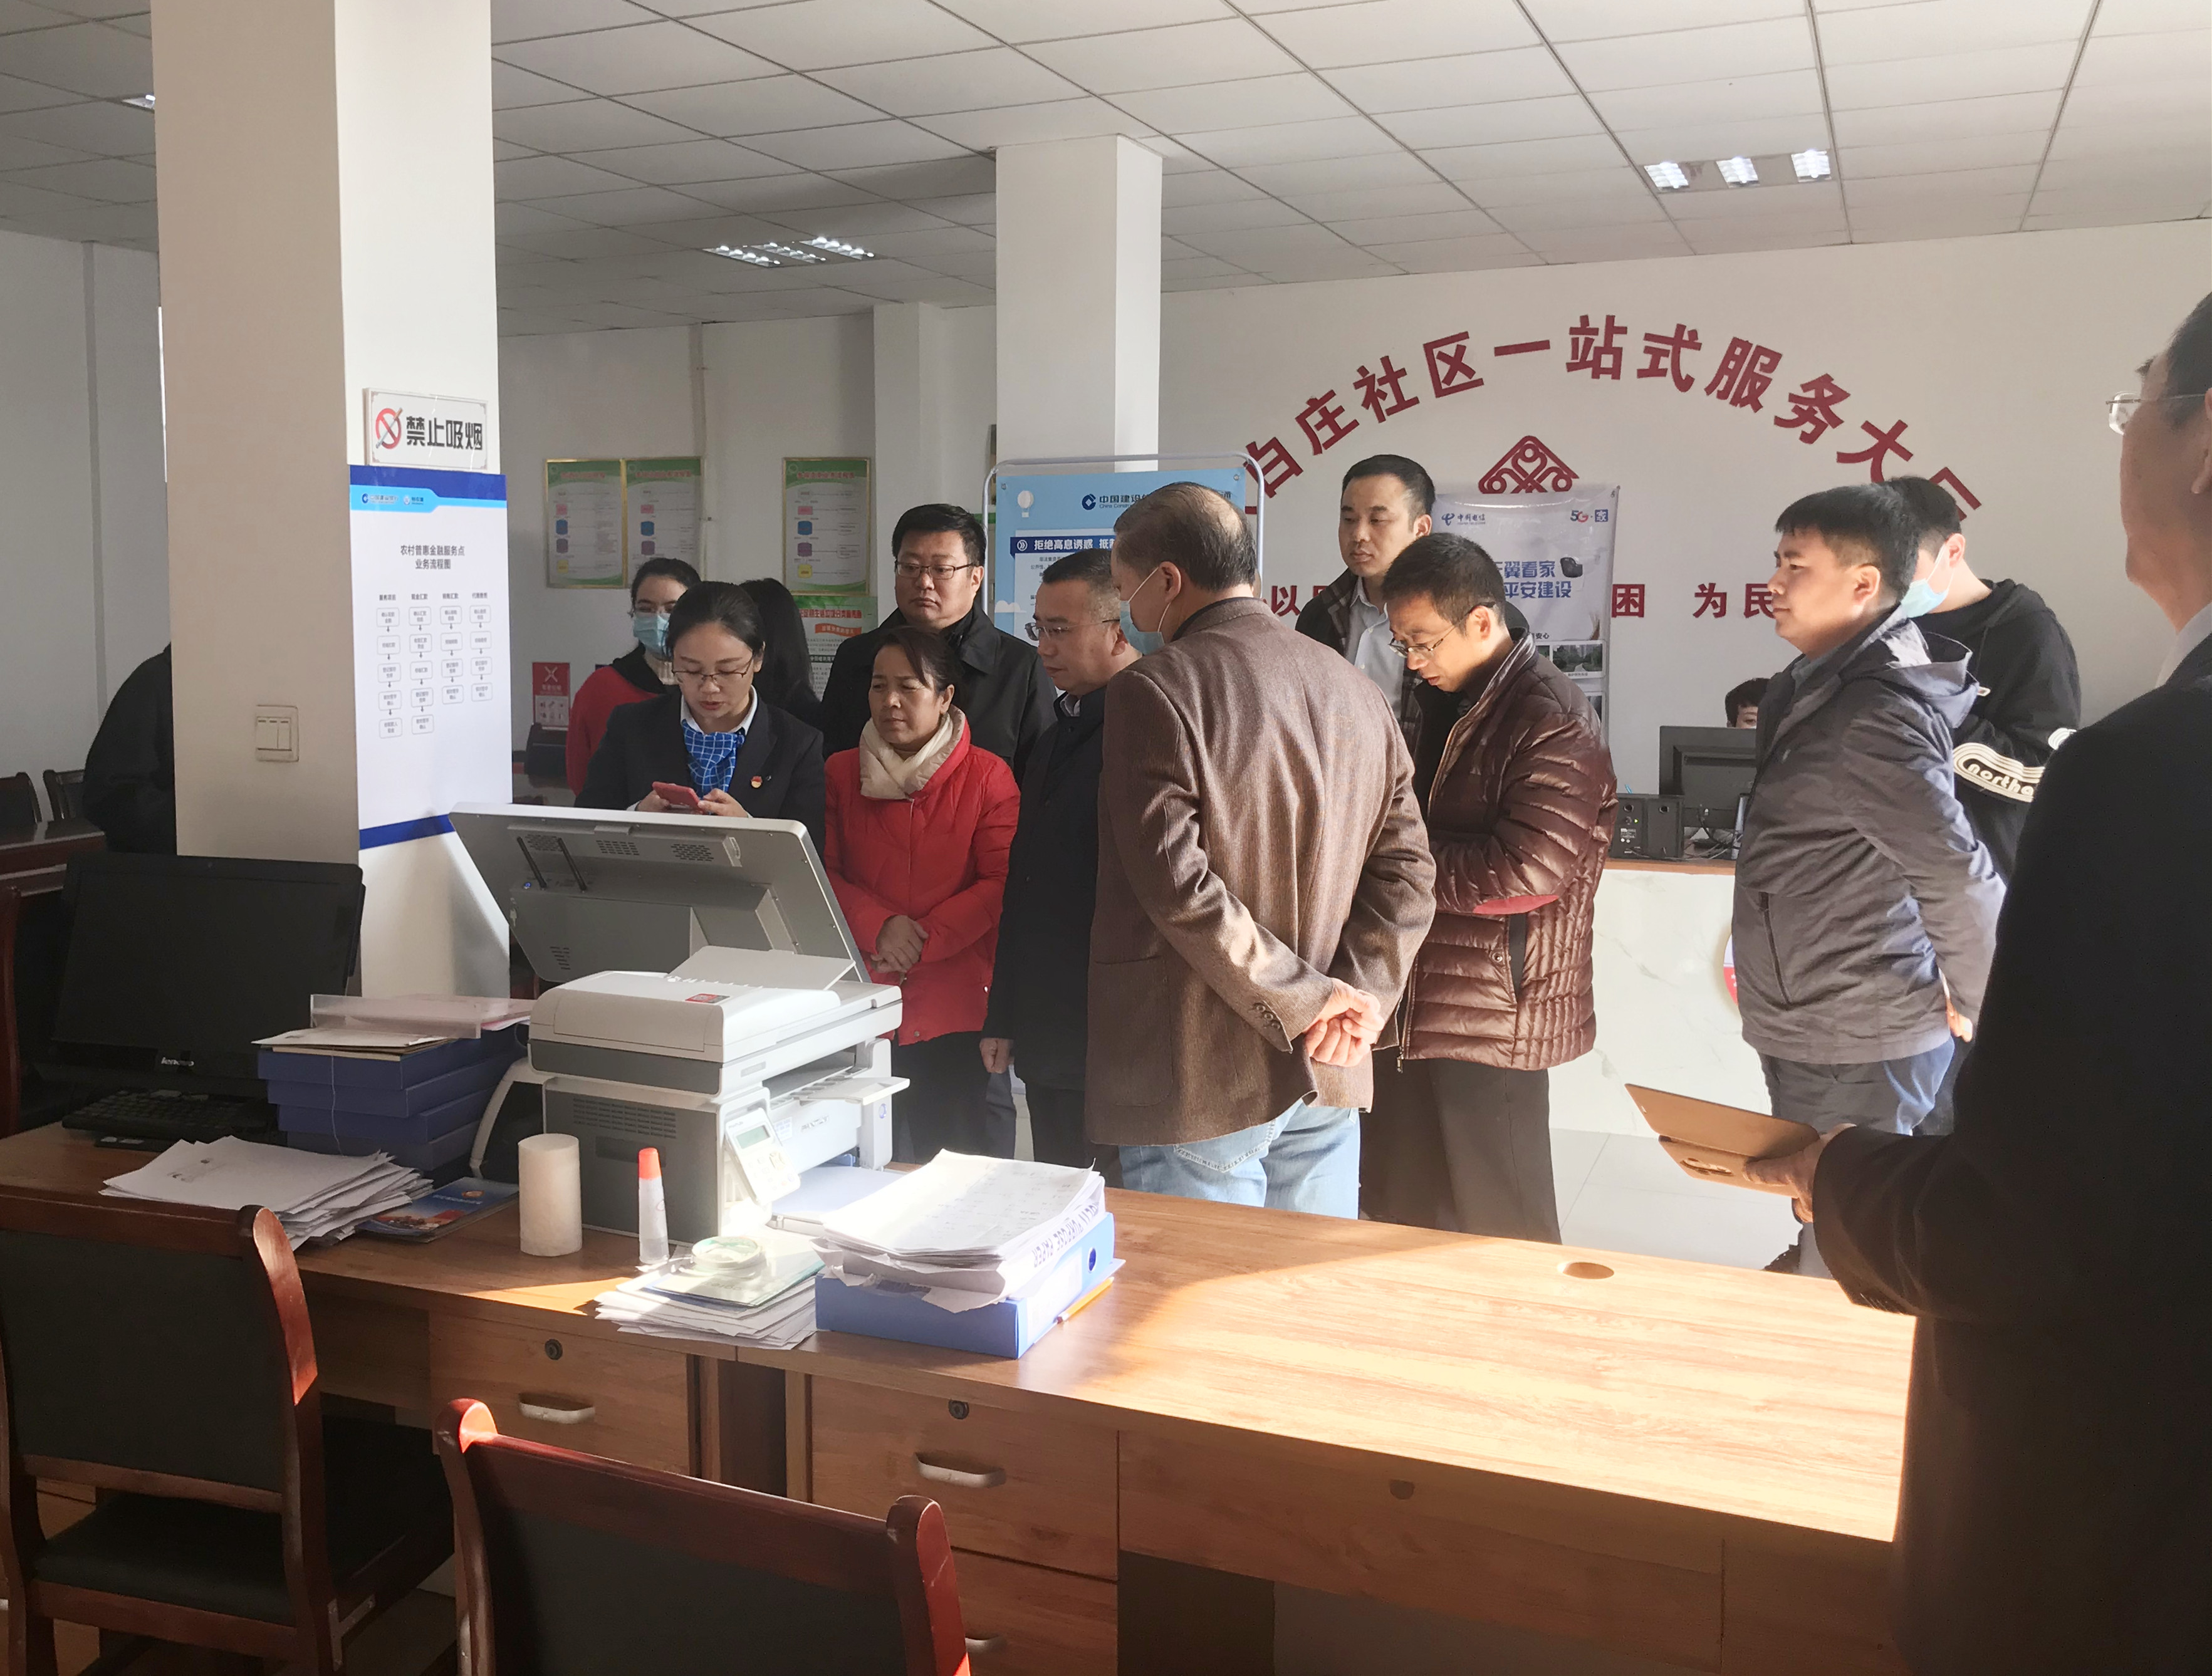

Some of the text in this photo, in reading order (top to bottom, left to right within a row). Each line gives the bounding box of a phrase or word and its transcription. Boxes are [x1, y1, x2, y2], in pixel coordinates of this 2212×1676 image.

[406, 415, 483, 450] 禁止吸烟
[1458, 513, 1486, 522] 中国电信
[400, 544, 466, 556] 农村普惠金融服务点
[1034, 538, 1093, 551] 拒绝高息诱惑
[415, 558, 451, 570] 业务流程图
[1503, 581, 1572, 599] 平安建设
[1031, 1237, 1054, 1268] PAPER
